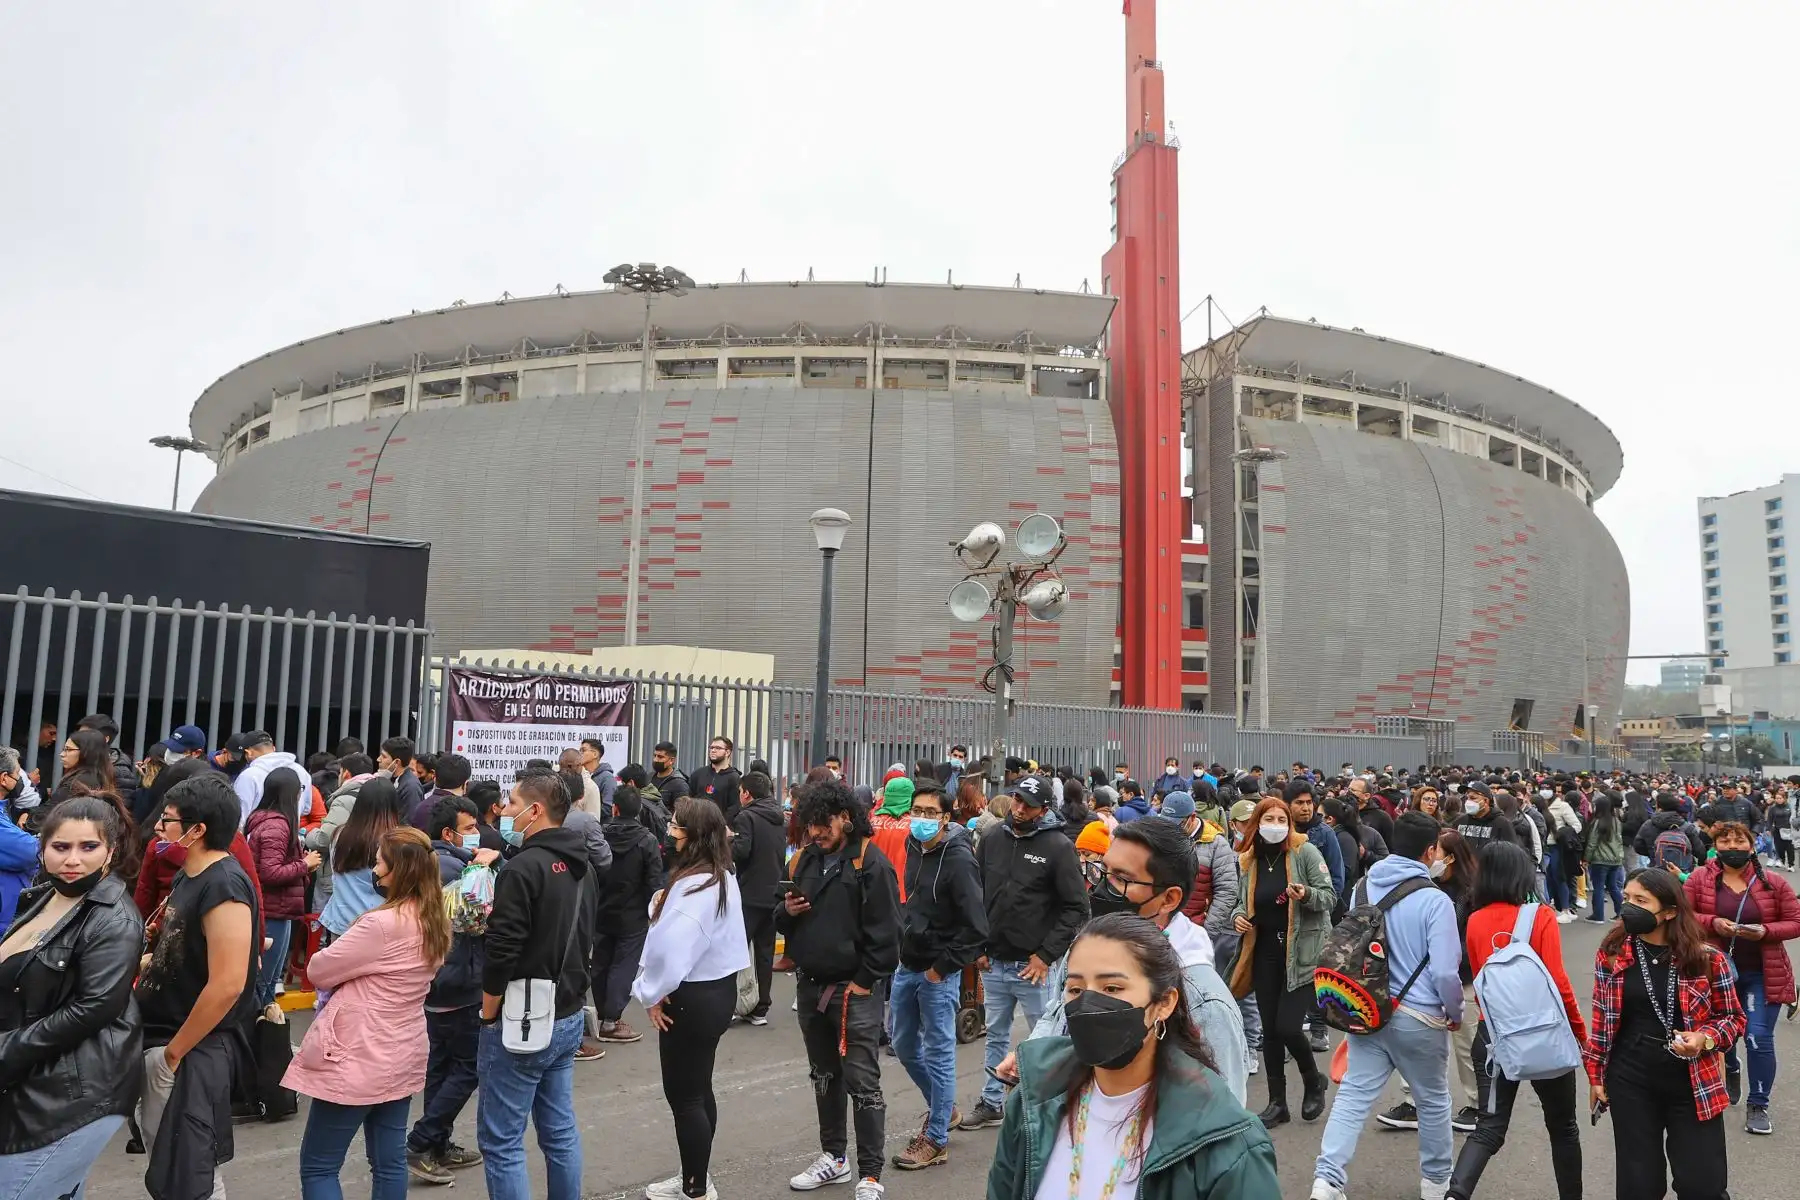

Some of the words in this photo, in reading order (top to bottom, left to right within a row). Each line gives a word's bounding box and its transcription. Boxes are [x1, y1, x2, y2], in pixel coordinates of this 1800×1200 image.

[458, 677, 532, 699] ARTÍCULOS
[535, 682, 550, 700] NO
[555, 684, 627, 704] PERMITIDOS
[504, 703, 517, 717] EN
[520, 704, 533, 717] EL
[535, 704, 586, 719] CONCIERTO
[467, 729, 516, 741] DISPOSITIVOS
[518, 730, 527, 741] DE
[567, 732, 576, 742] DE
[467, 744, 492, 755] ARMAS
[494, 745, 503, 755] DE
[505, 745, 542, 756] CUALQUIER
[543, 746, 559, 756] TIPO
[468, 759, 508, 770] LEMENTOS
